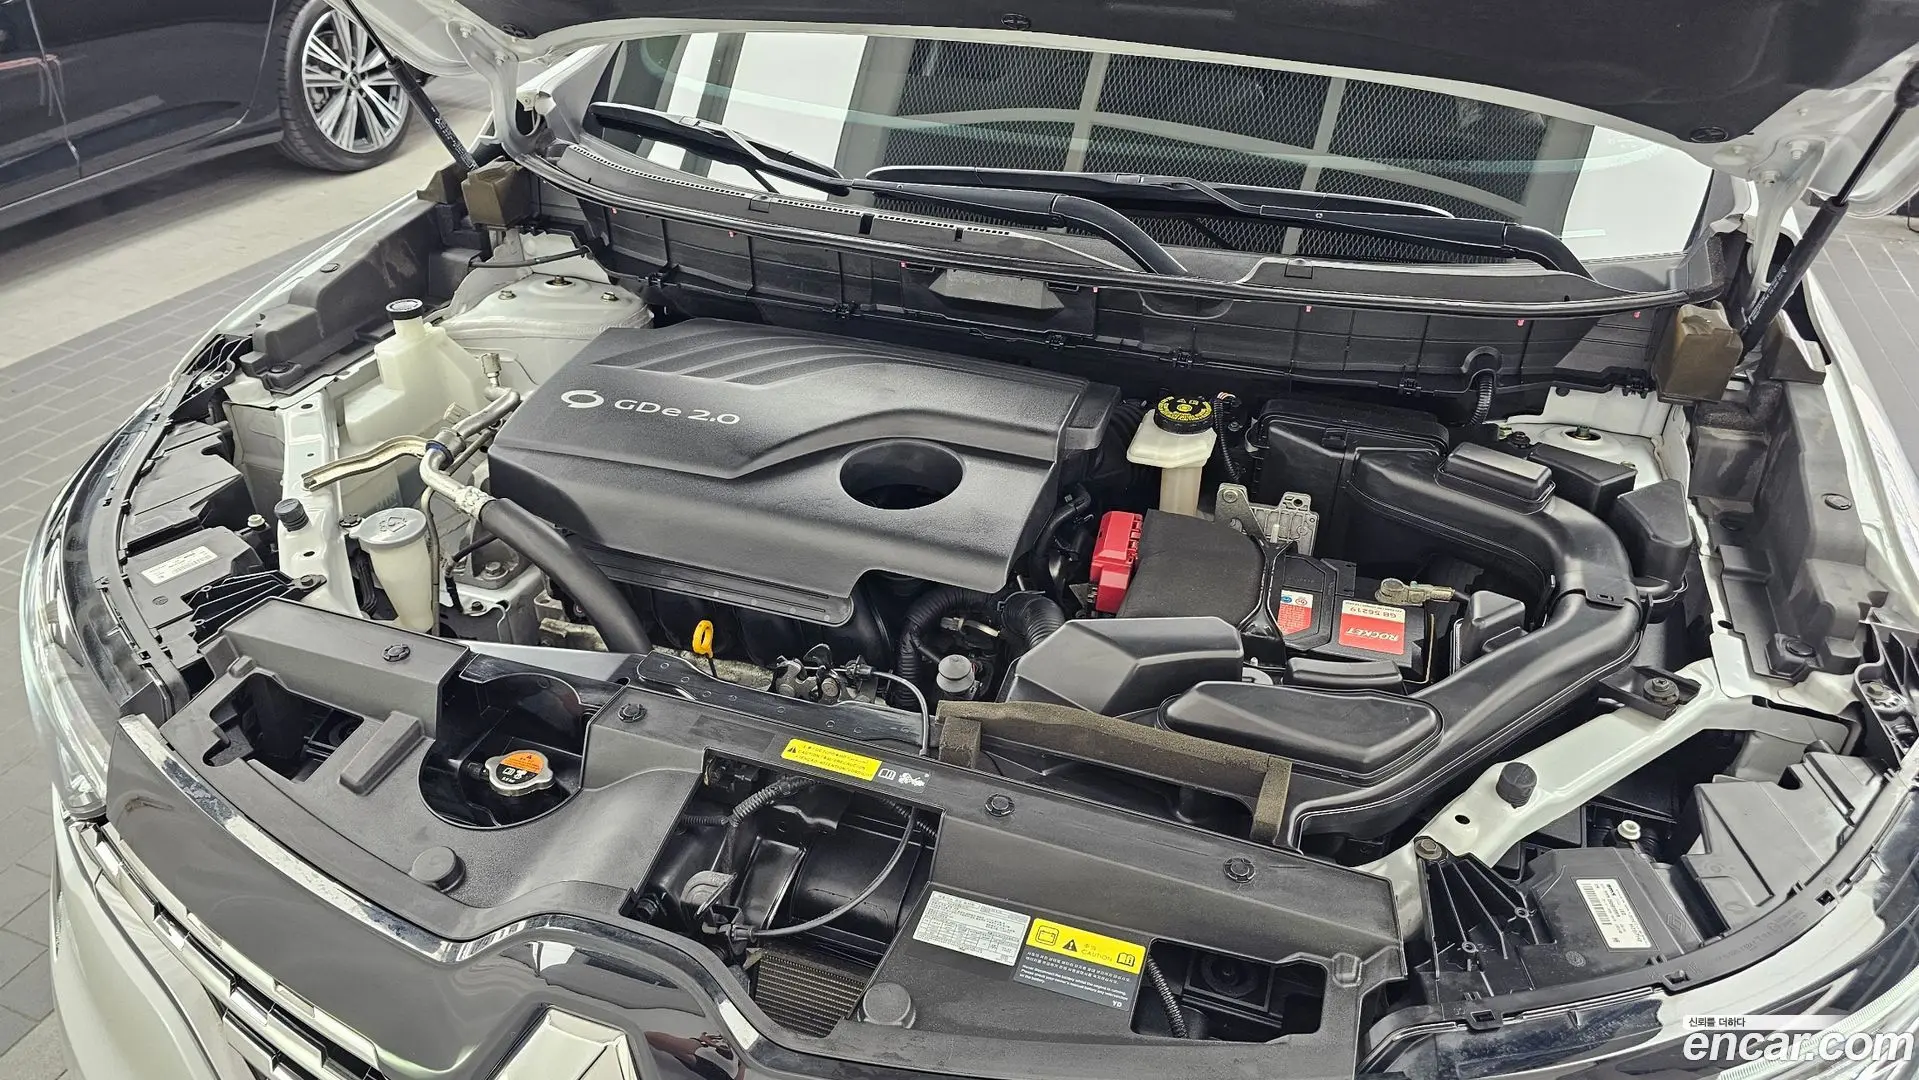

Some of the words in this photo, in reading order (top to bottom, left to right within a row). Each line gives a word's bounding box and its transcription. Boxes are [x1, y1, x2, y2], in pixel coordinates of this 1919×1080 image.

[614, 399, 682, 417] GDe
[688, 409, 741, 425] 2.0
[1346, 627, 1400, 642] ROCKET
[1081, 948, 1113, 962] CAUTION
